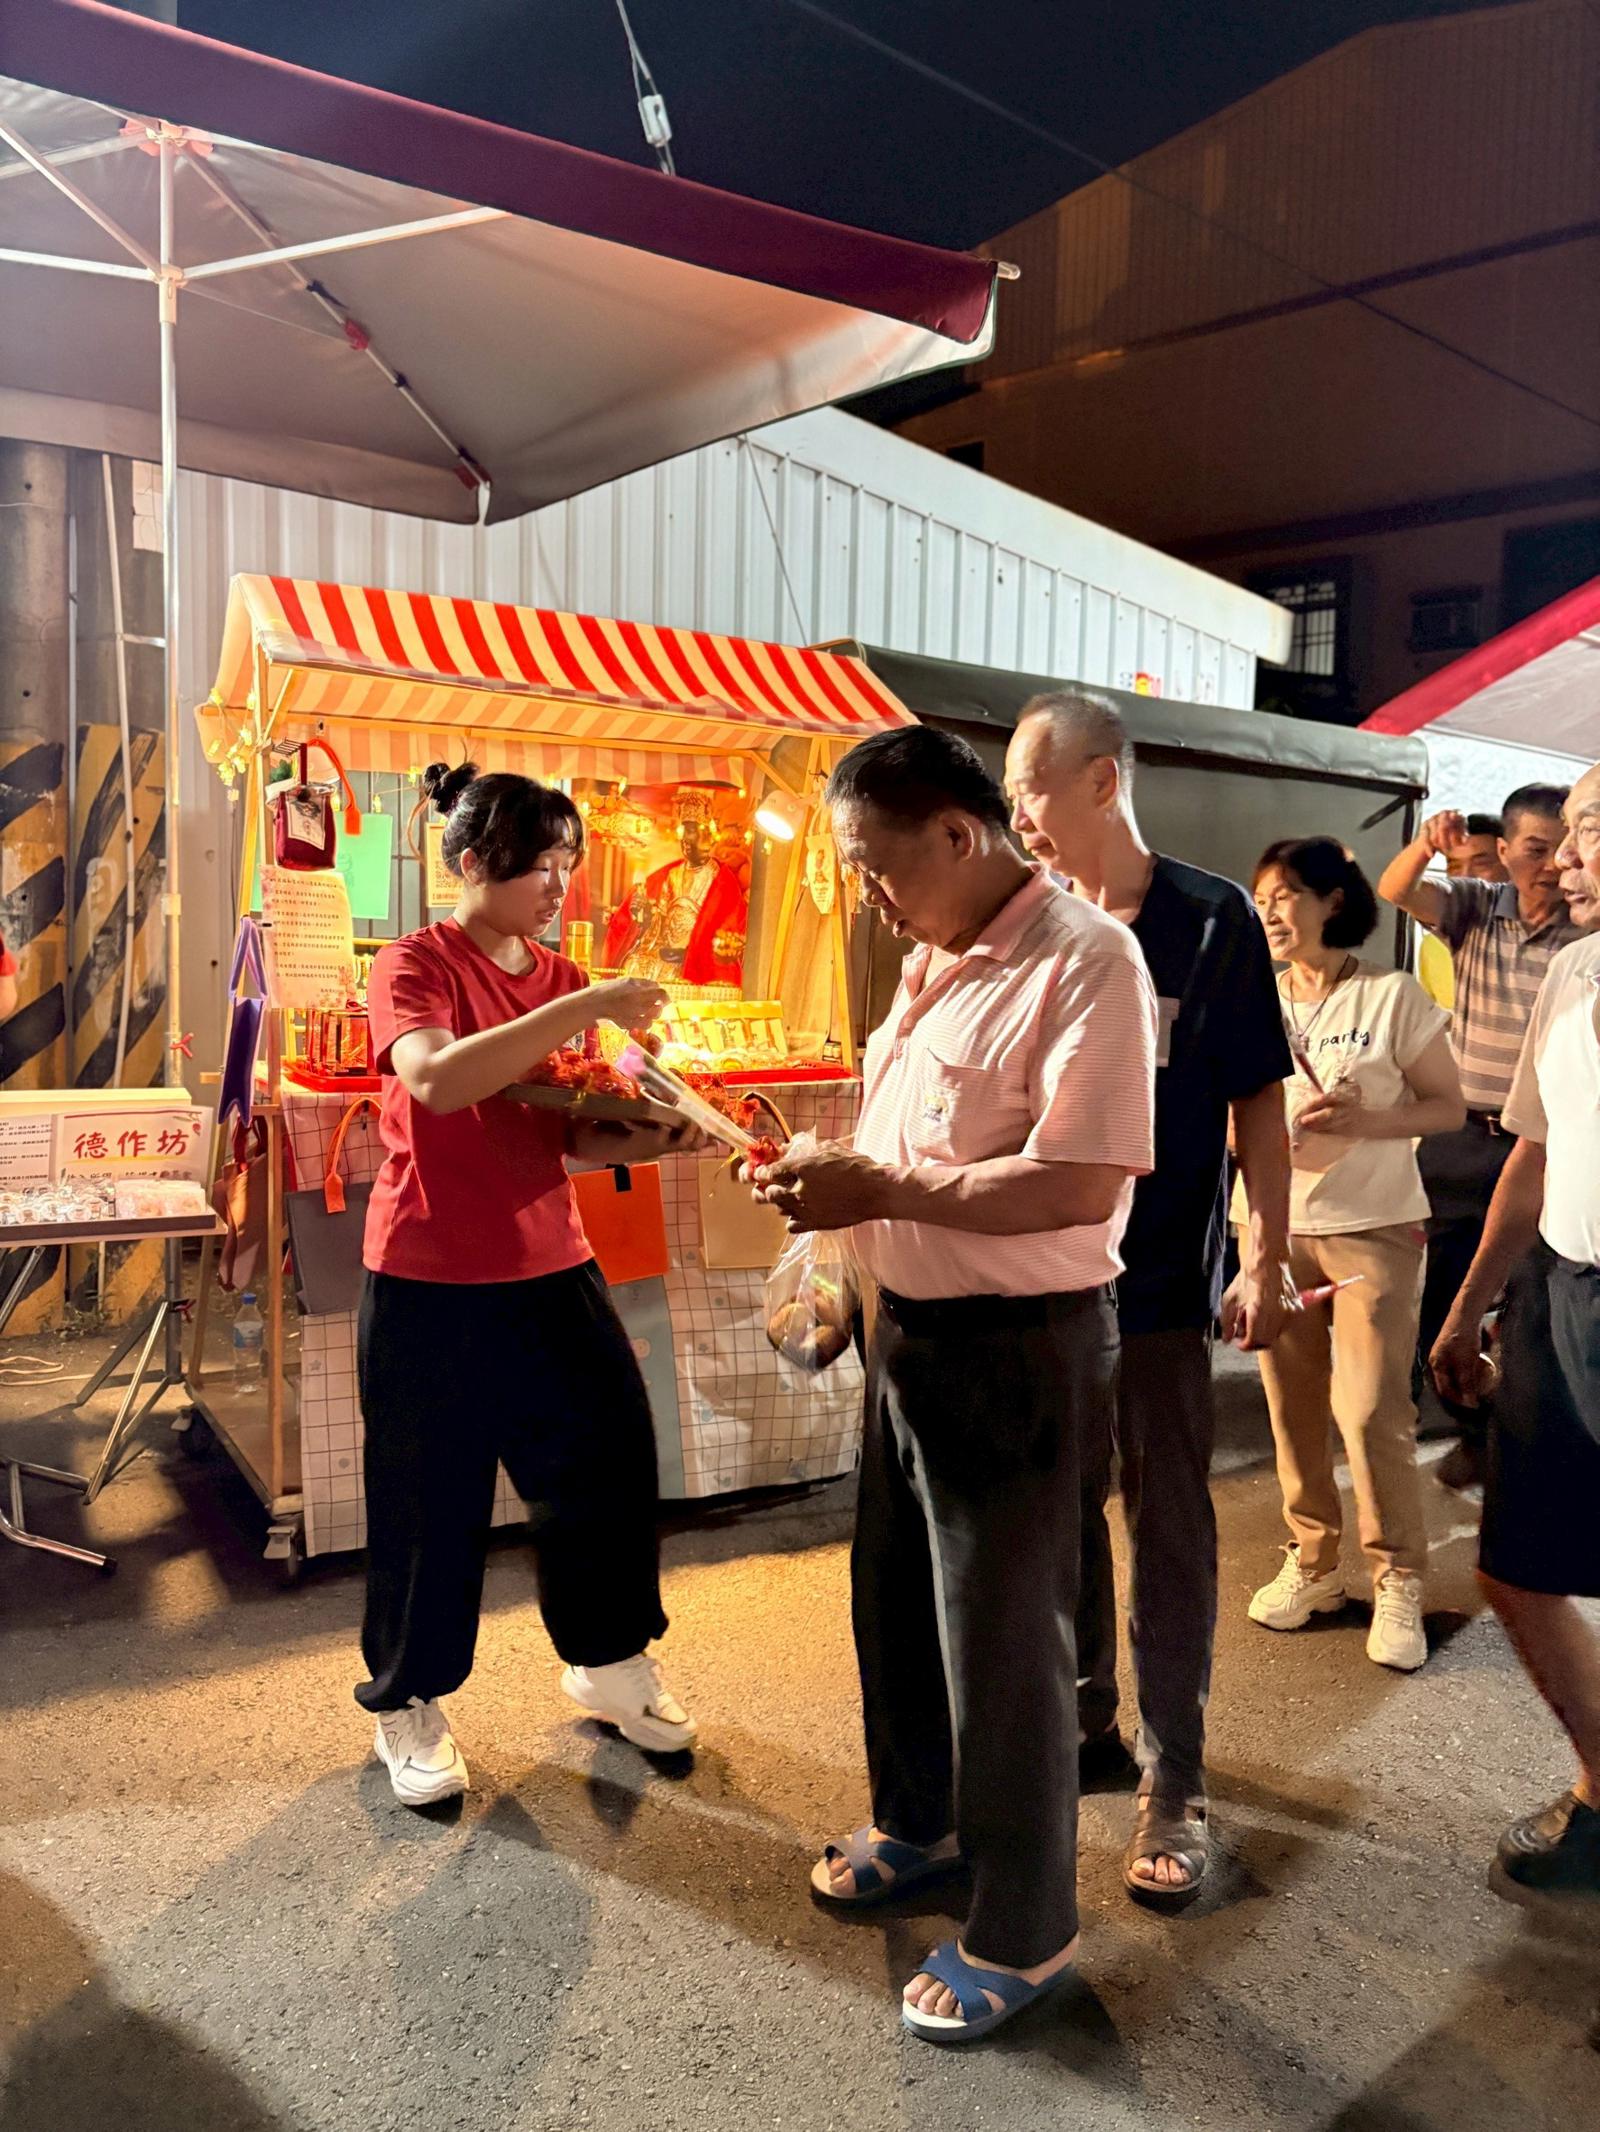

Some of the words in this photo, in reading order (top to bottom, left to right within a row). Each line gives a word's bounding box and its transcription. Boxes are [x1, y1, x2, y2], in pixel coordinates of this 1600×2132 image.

[1319, 1027, 1370, 1052] party
[73, 1128, 189, 1159] 德作坊
